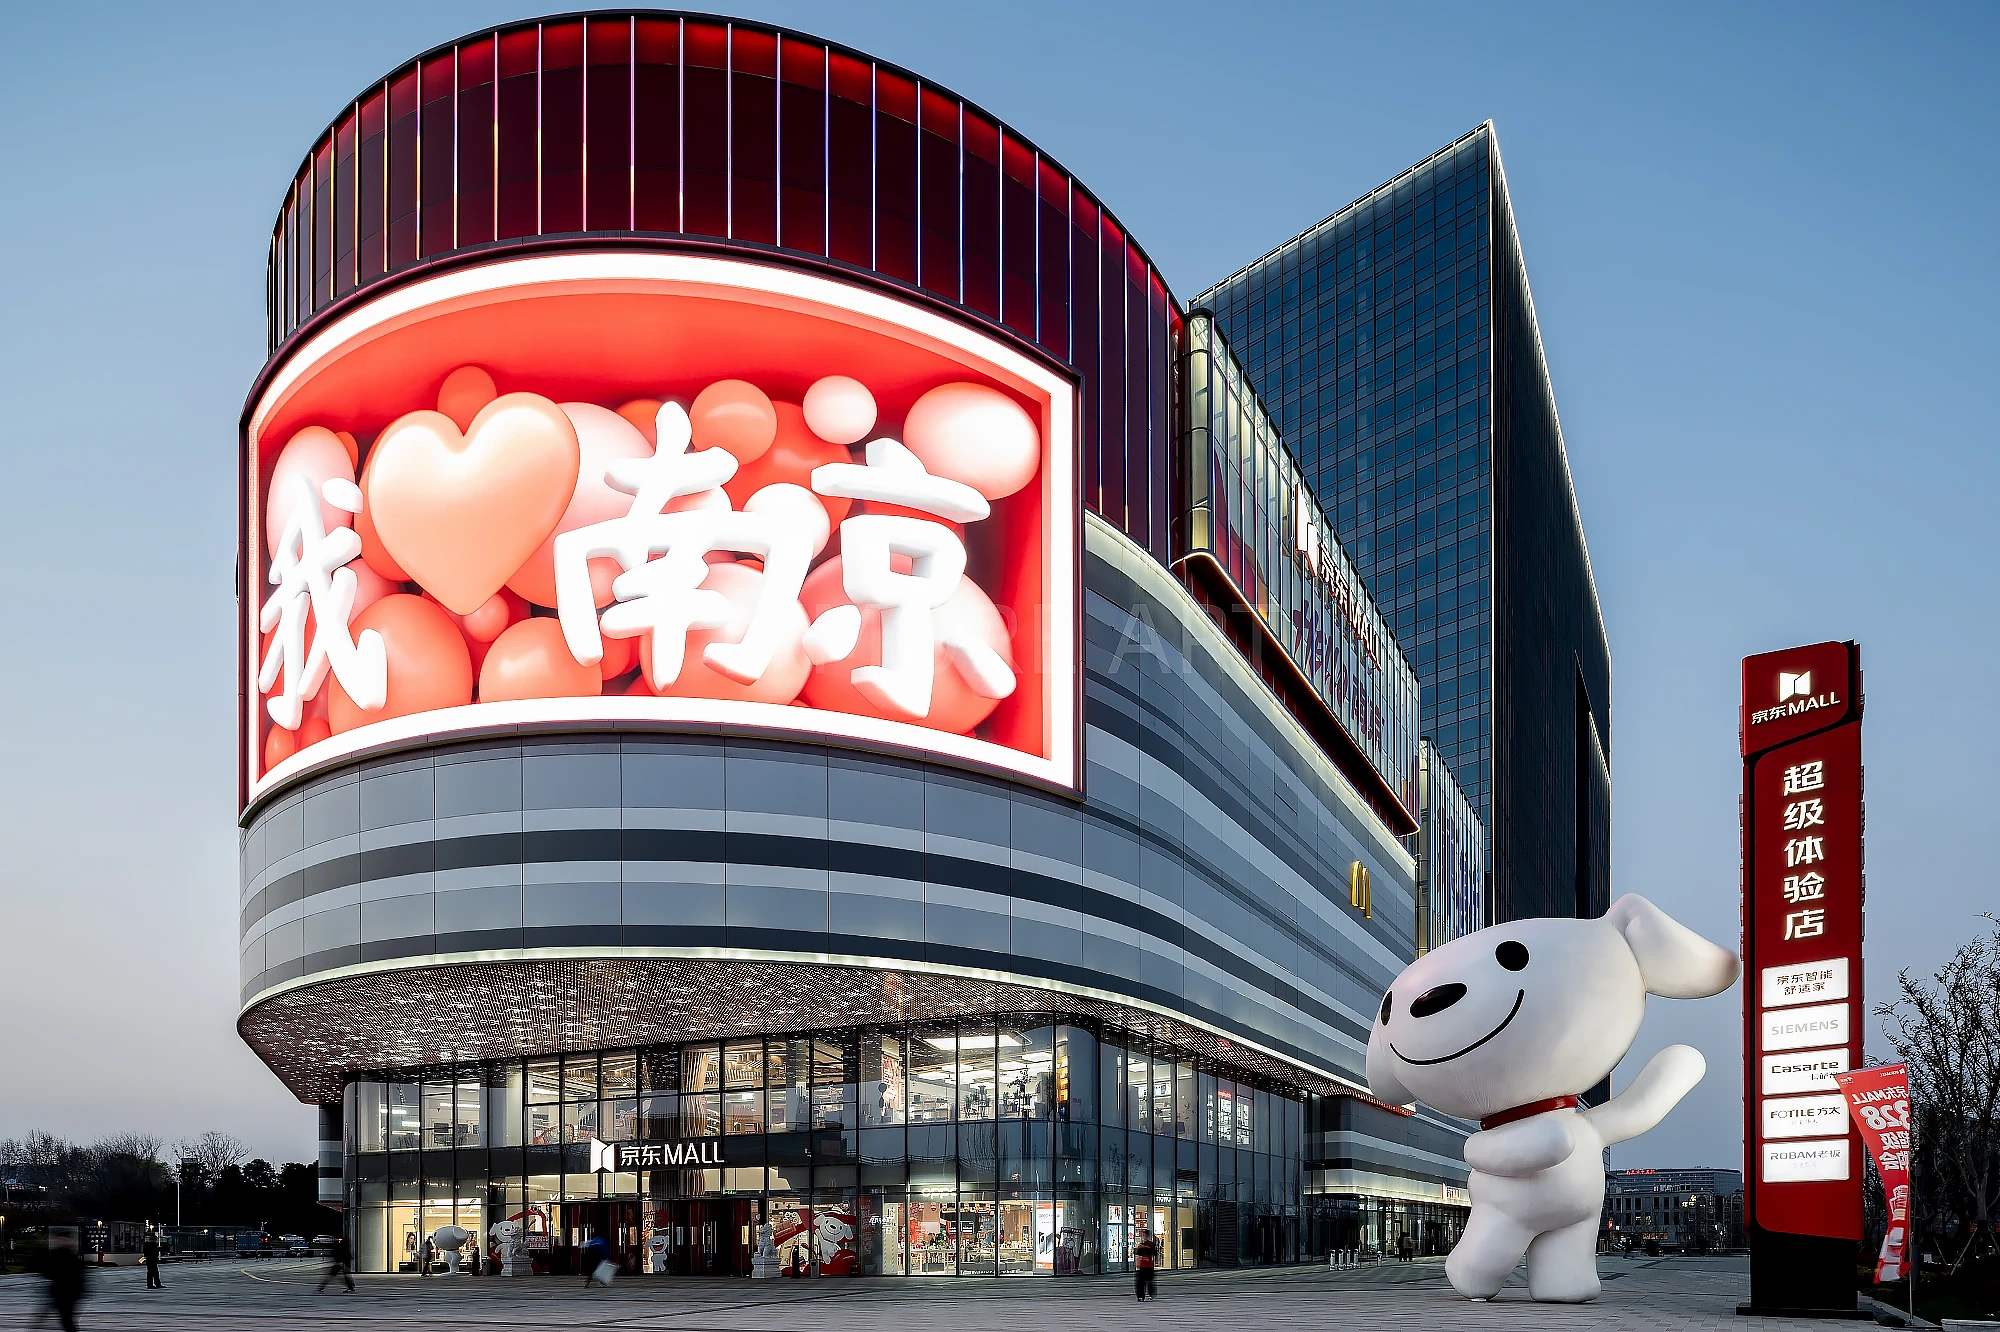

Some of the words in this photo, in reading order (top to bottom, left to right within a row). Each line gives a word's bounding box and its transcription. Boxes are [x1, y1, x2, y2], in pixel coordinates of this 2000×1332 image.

[258, 475, 387, 731] 我
[554, 400, 1016, 718] 南京
[1751, 691, 1841, 725] 京东MALL
[1783, 760, 1825, 941] 超级体验店
[1776, 969, 1833, 986] 京东智能
[1771, 1019, 1839, 1036] SIEMENS
[1771, 1061, 1839, 1074] Casarte
[1770, 1108, 1815, 1119] FOTILE
[620, 1141, 725, 1167] 京东MALL
[1770, 1150, 1817, 1160] ROBAM
